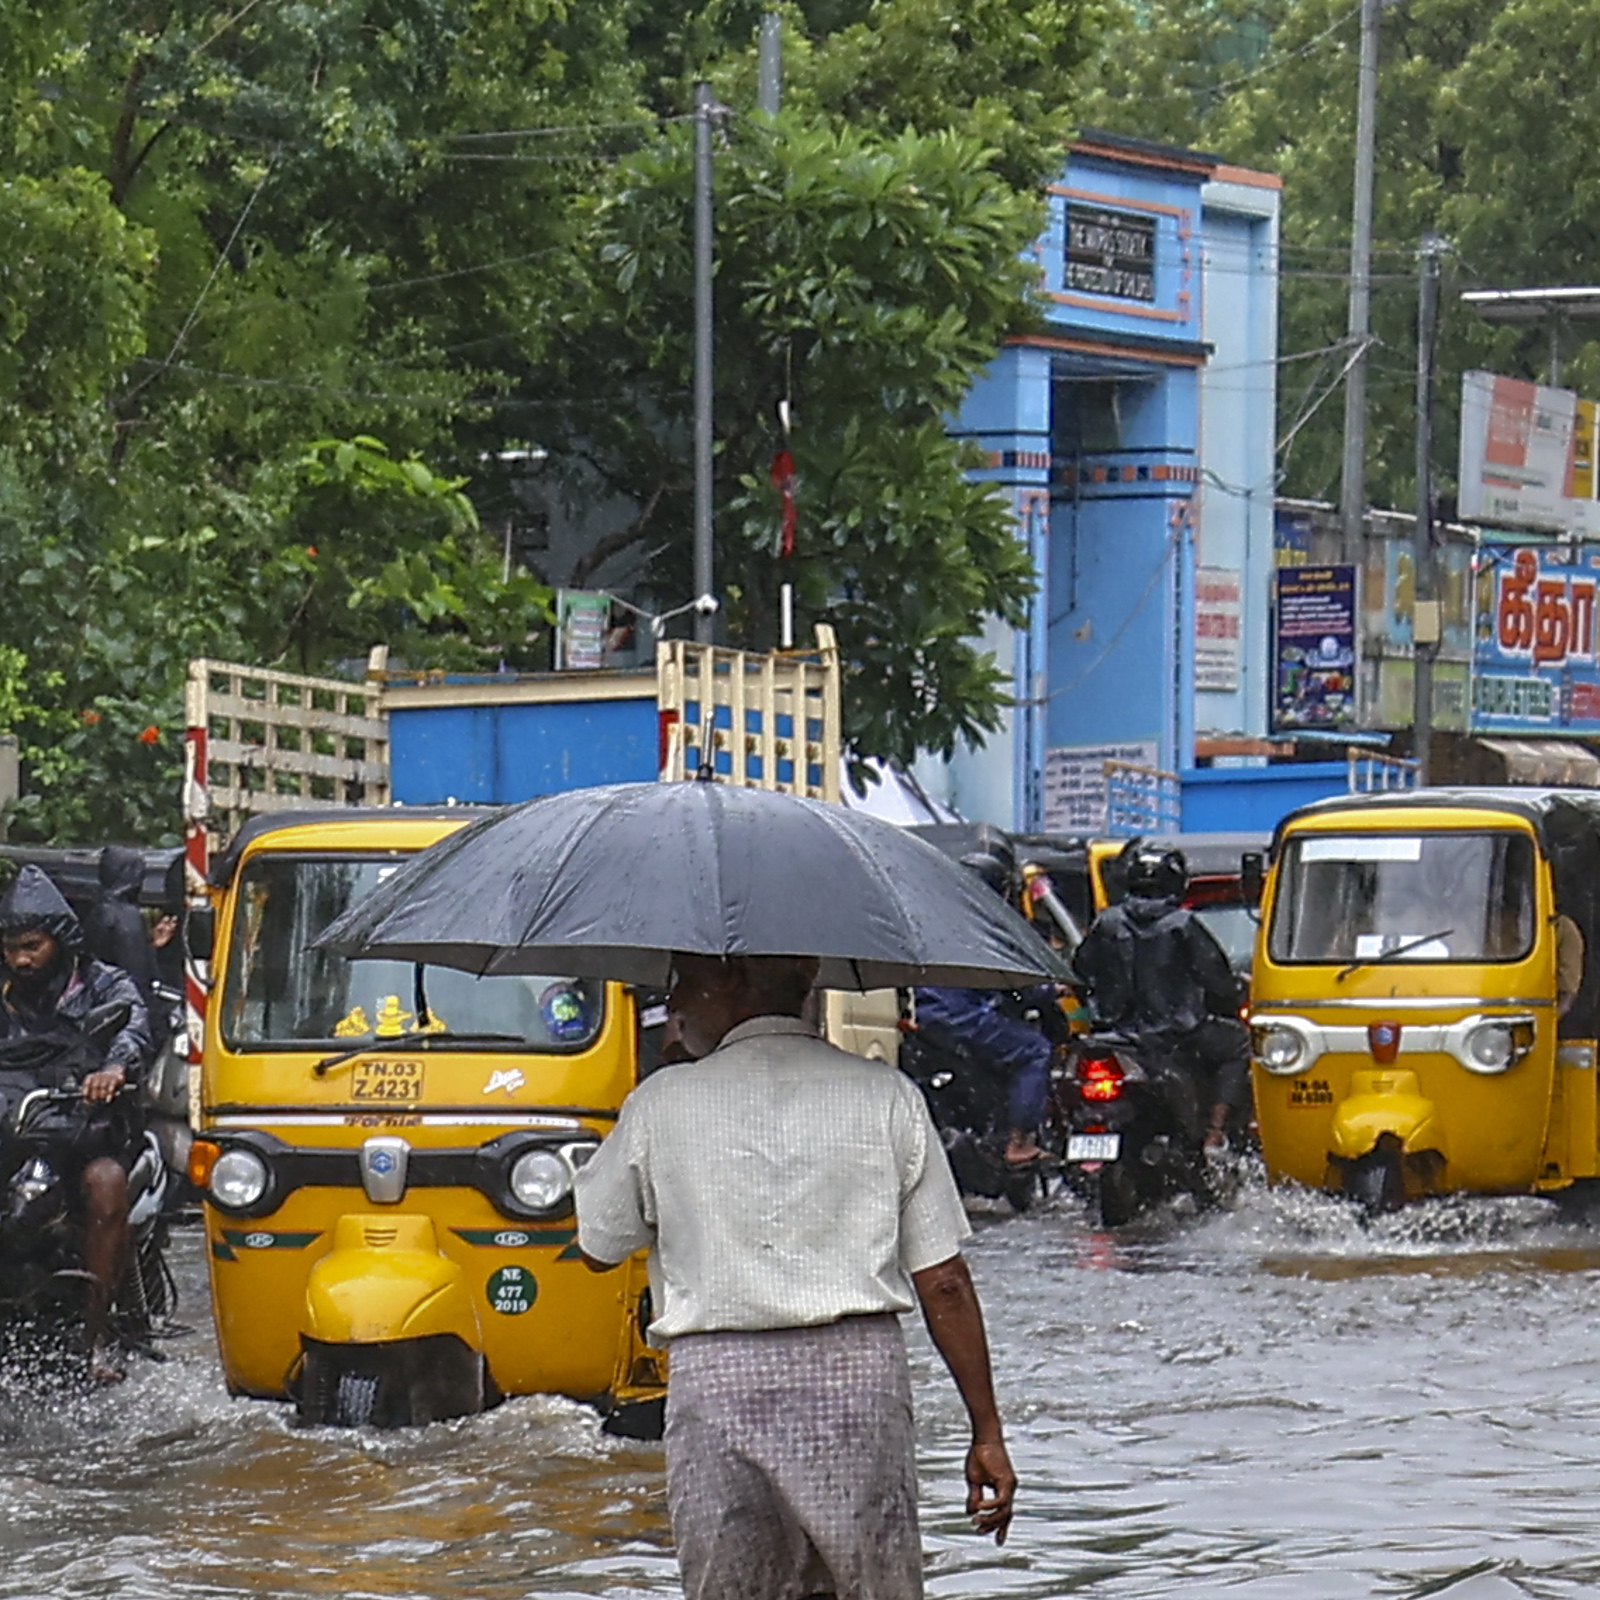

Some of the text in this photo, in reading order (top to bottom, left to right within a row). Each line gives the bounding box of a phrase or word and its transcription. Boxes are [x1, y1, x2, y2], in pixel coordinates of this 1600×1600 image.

[1498, 549, 1597, 668] கீதா
[360, 1063, 417, 1077] TN.03
[354, 1080, 422, 1098] Z.4231
[502, 1268, 522, 1281] NE
[497, 1286, 523, 1298] 477
[495, 1299, 528, 1312] 2019
